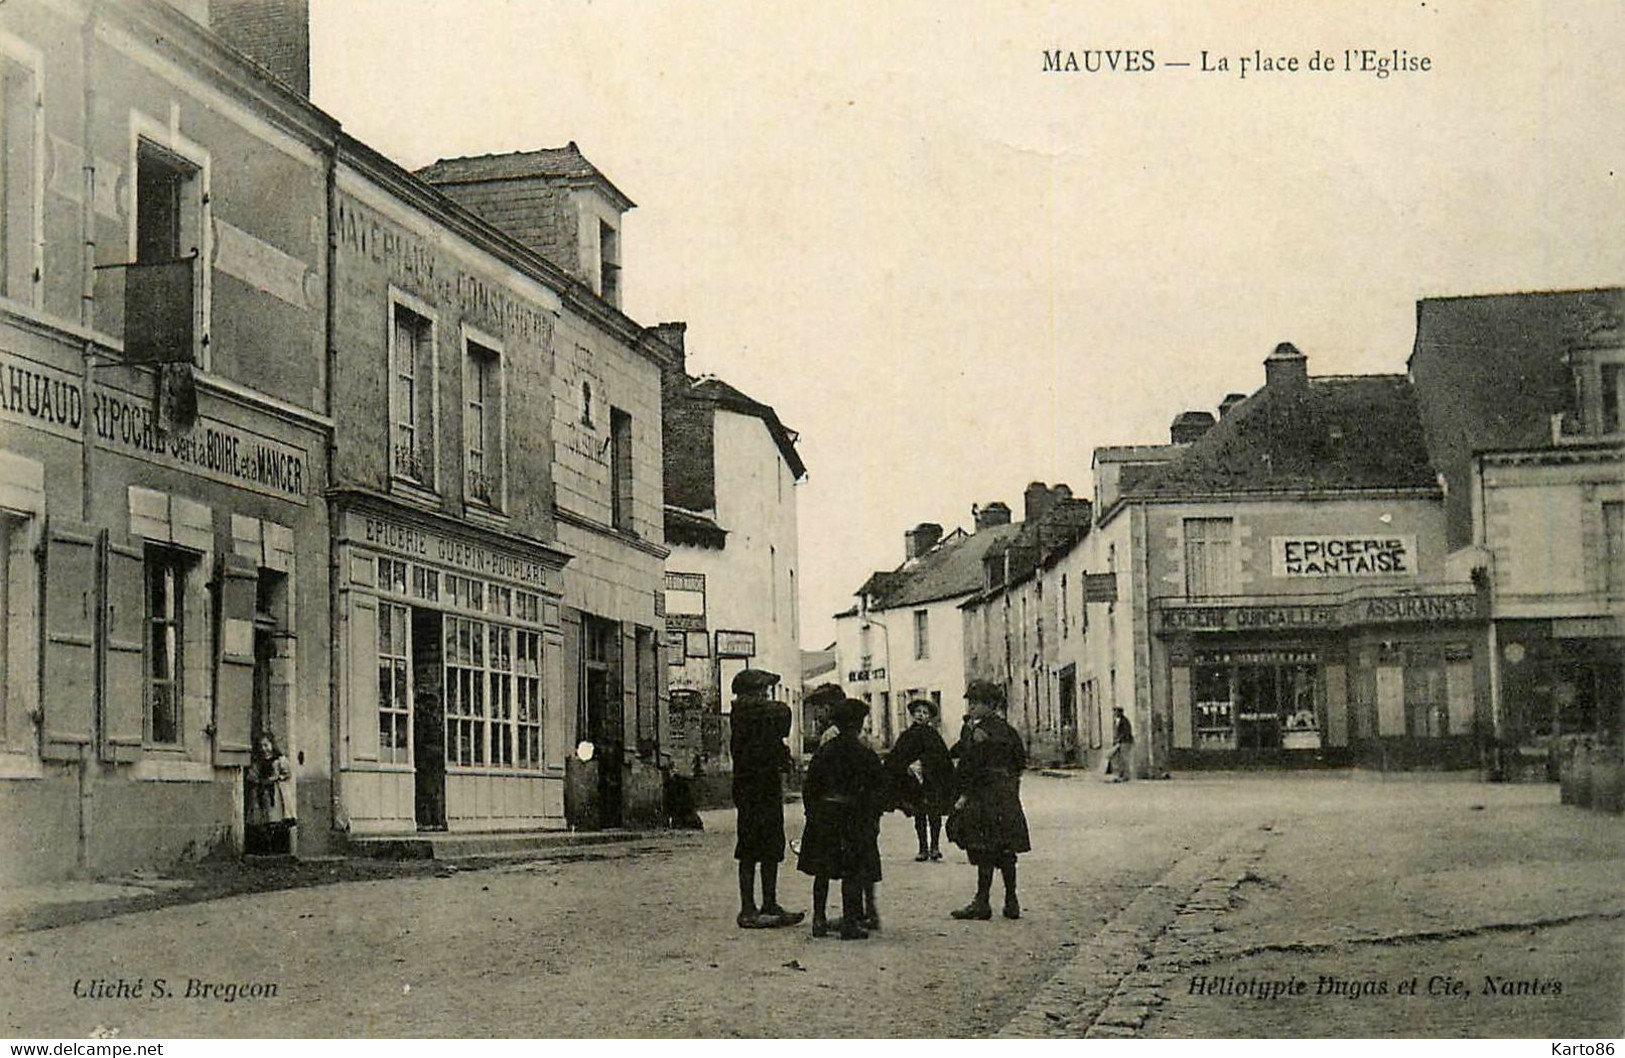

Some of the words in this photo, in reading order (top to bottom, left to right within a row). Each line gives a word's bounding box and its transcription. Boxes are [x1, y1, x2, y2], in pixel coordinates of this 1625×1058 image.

[206, 429, 240, 478] BOIRE
[366, 519, 427, 555] EPICERIE
[1284, 540, 1402, 563] EPICERIE
[1286, 549, 1407, 574] NANTAISE
[1366, 597, 1476, 616] ASSURANCES
